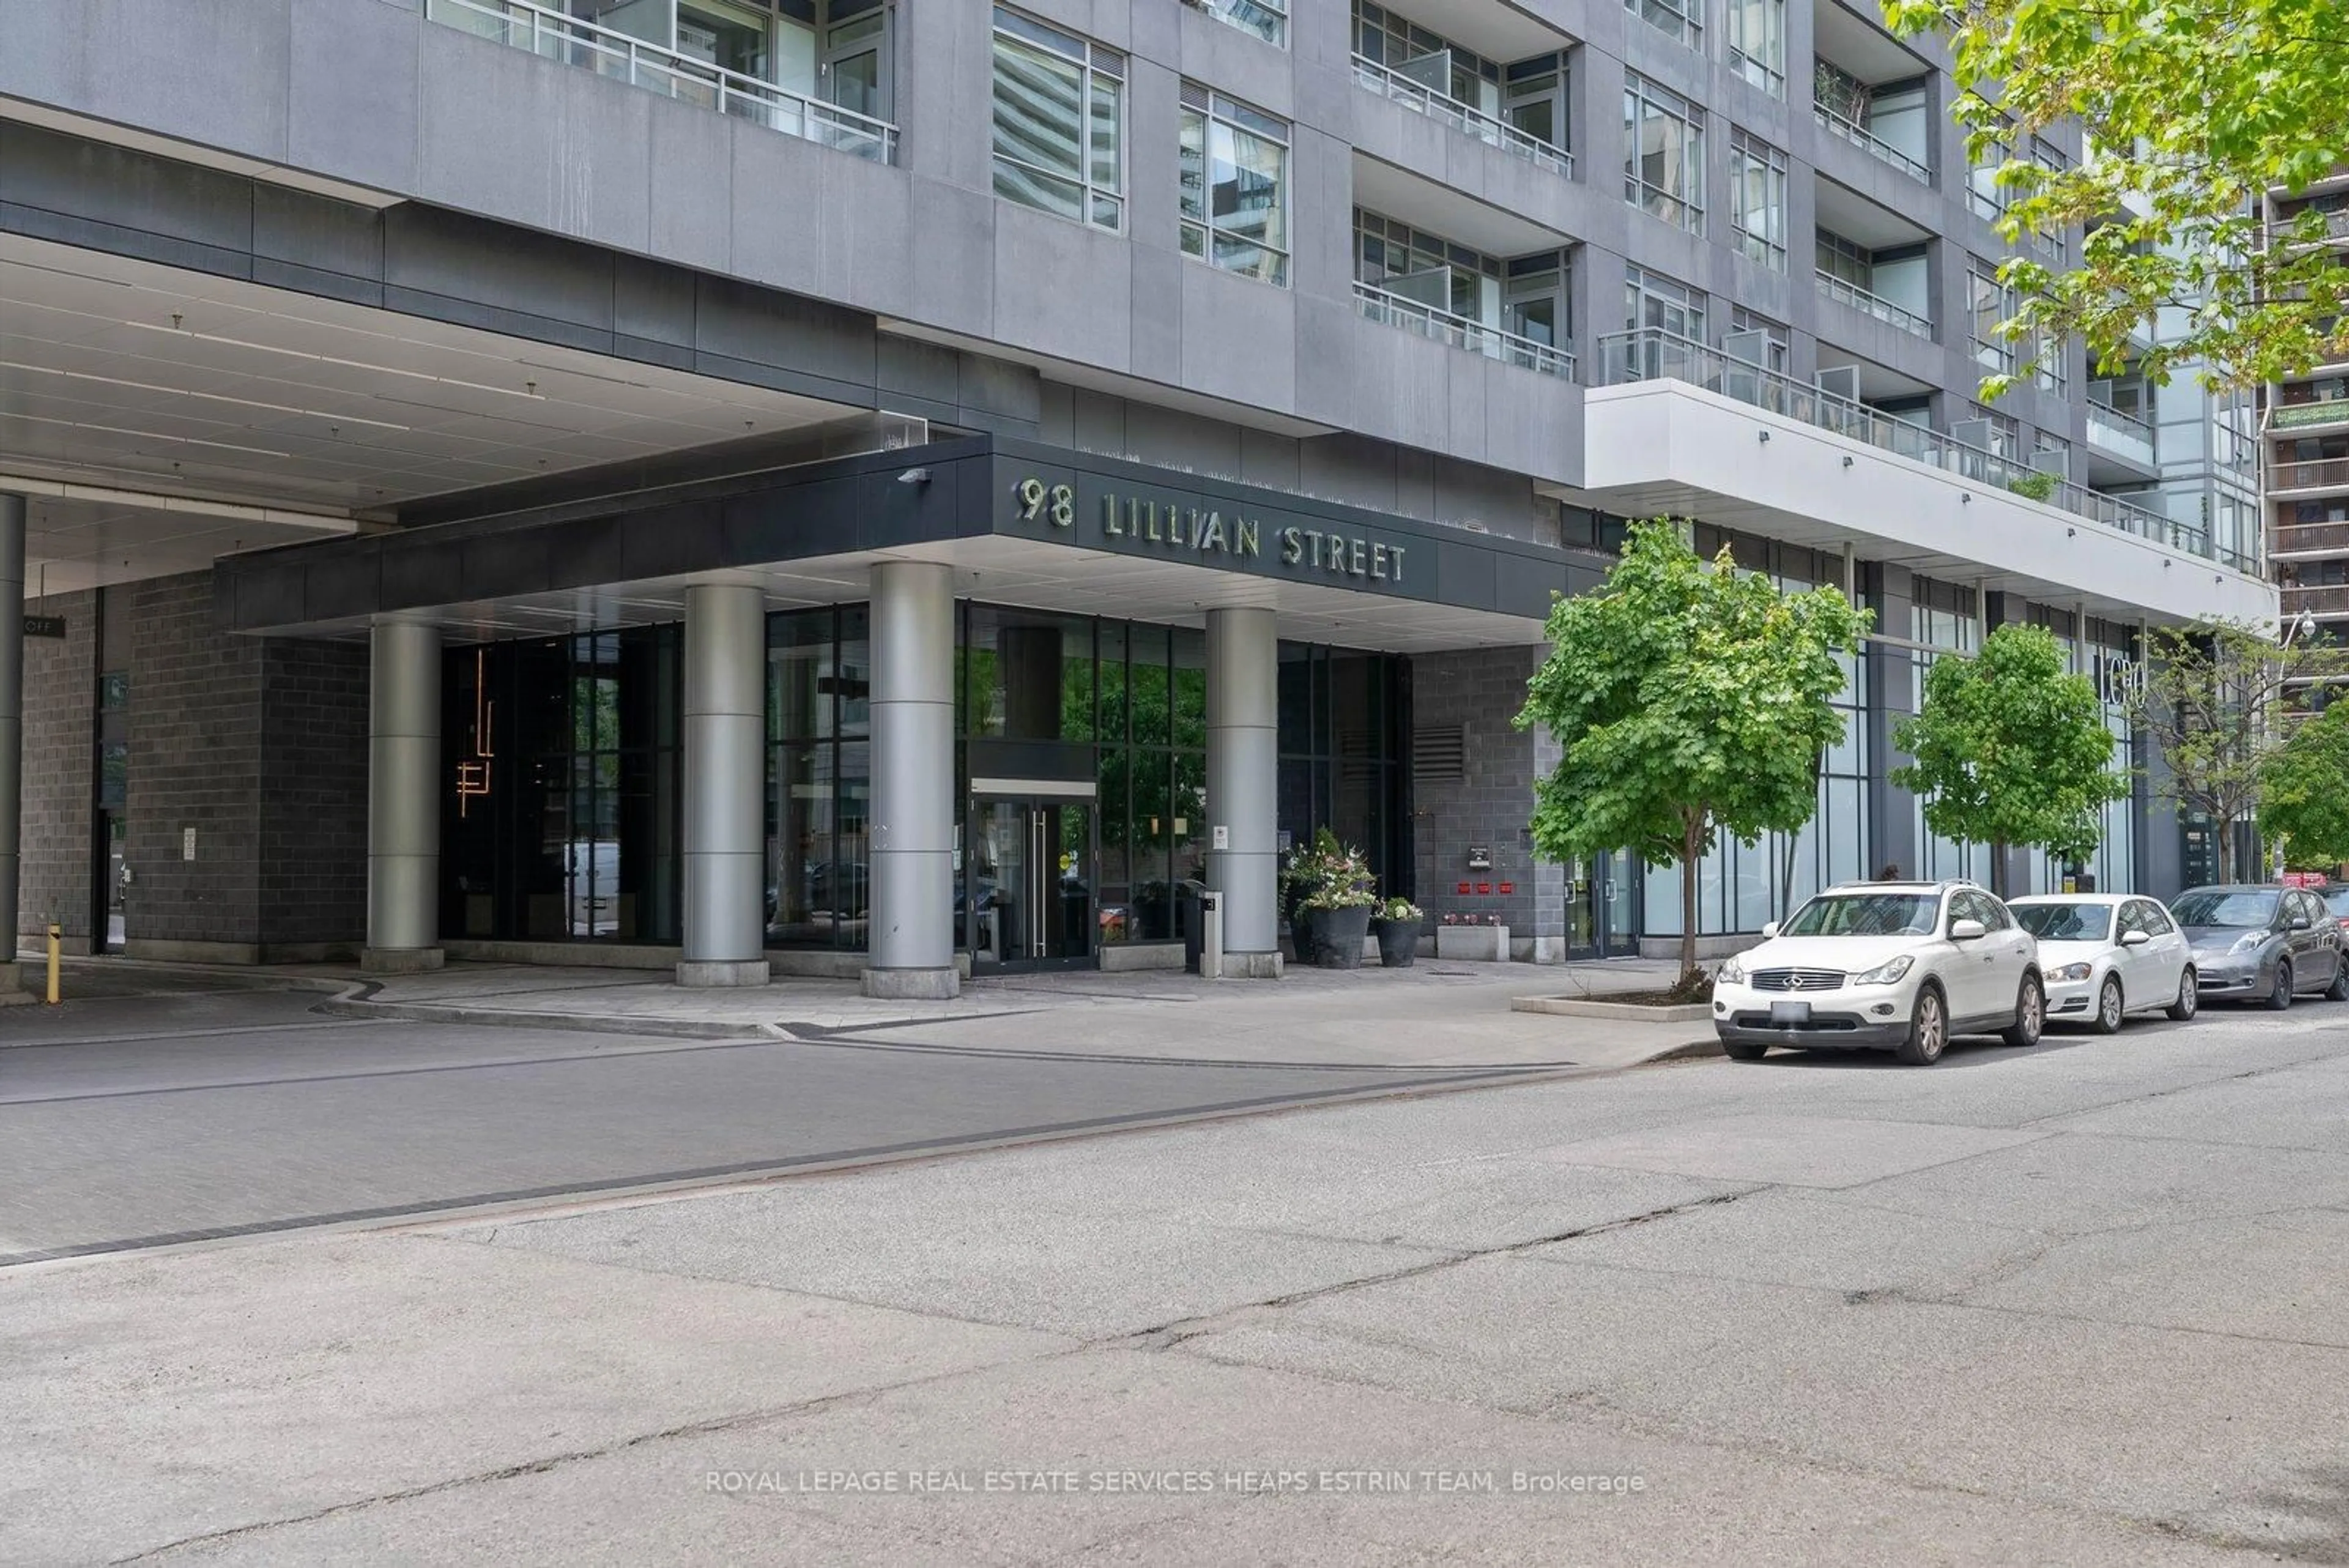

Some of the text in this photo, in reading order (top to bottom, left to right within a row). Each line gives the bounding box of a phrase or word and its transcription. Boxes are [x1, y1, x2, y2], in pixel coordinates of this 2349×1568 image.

[1018, 478, 1406, 581] 98 LILLIAN STREET
